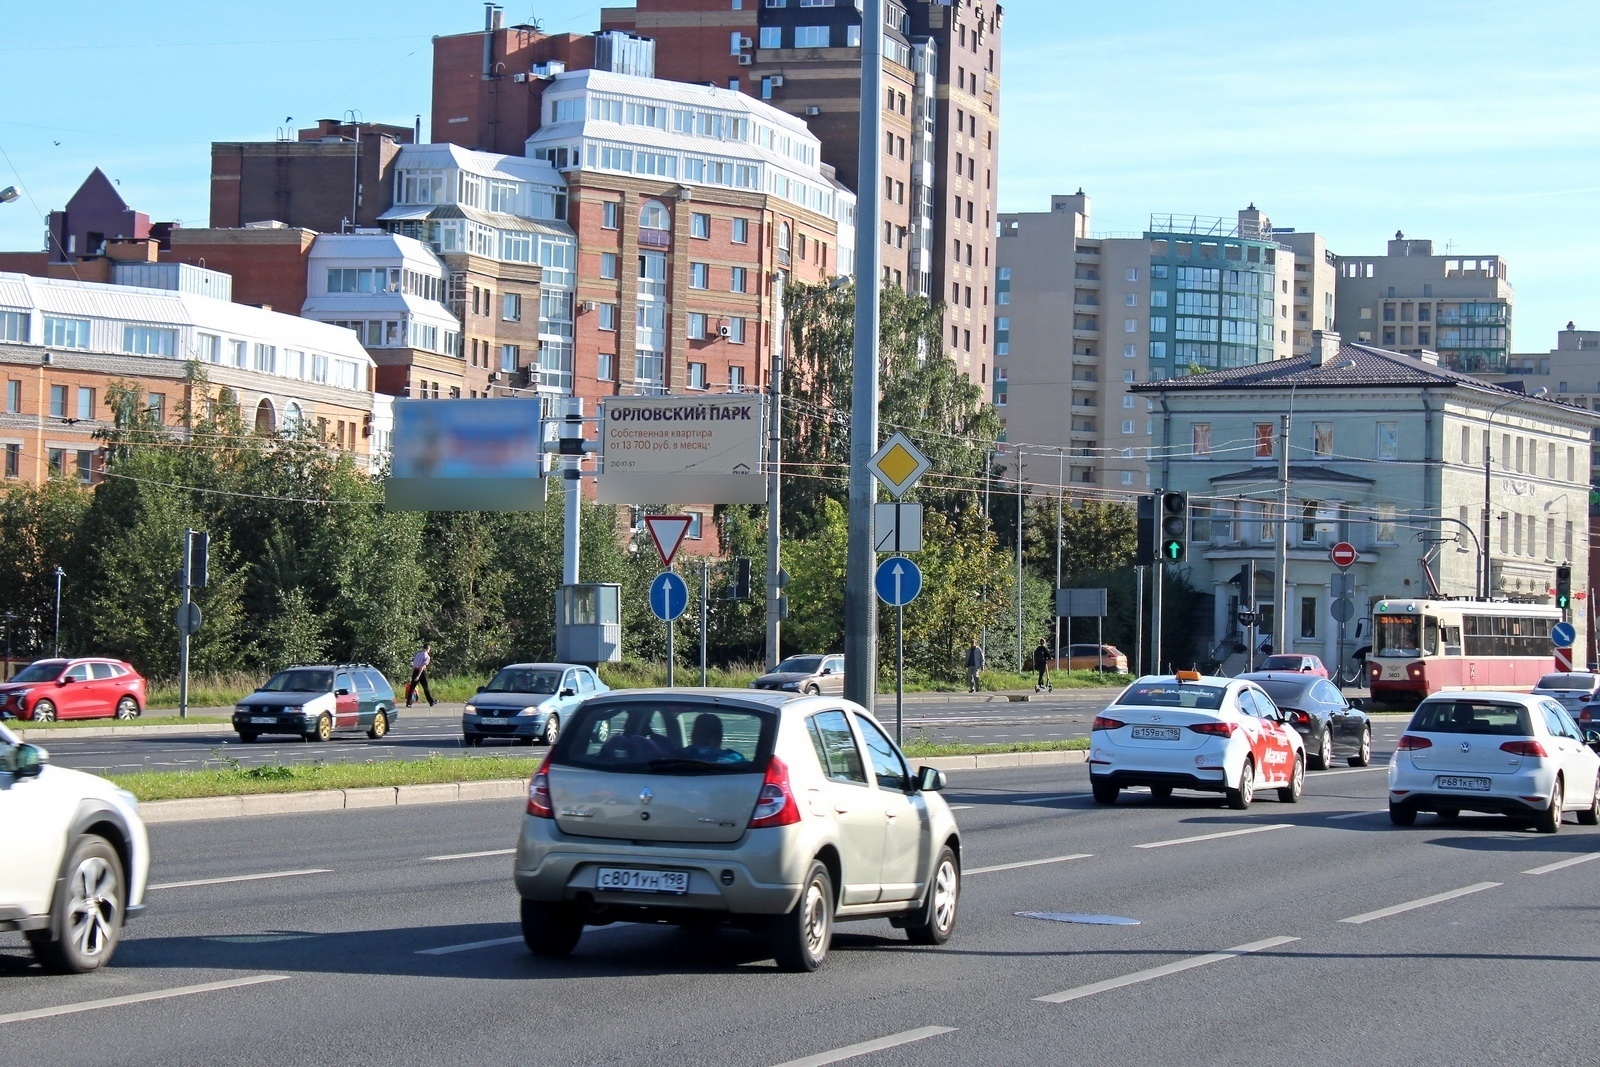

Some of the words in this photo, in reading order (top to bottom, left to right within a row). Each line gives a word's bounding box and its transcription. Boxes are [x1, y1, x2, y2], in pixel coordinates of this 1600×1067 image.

[610, 403, 706, 421] ОРЛОВСКИЙ
[709, 406, 752, 421] ПАРК
[610, 428, 669, 438] Собственная
[671, 429, 713, 439] квартира
[610, 442, 620, 450] от
[622, 440, 632, 450] 13
[633, 440, 651, 450] 700
[653, 440, 671, 451] руб.
[673, 442, 678, 450] в
[1134, 728, 1165, 737] В159ВХ
[1441, 778, 1474, 787] Р681КЕ
[601, 871, 659, 888] С801УН
[662, 872, 684, 885] 198
